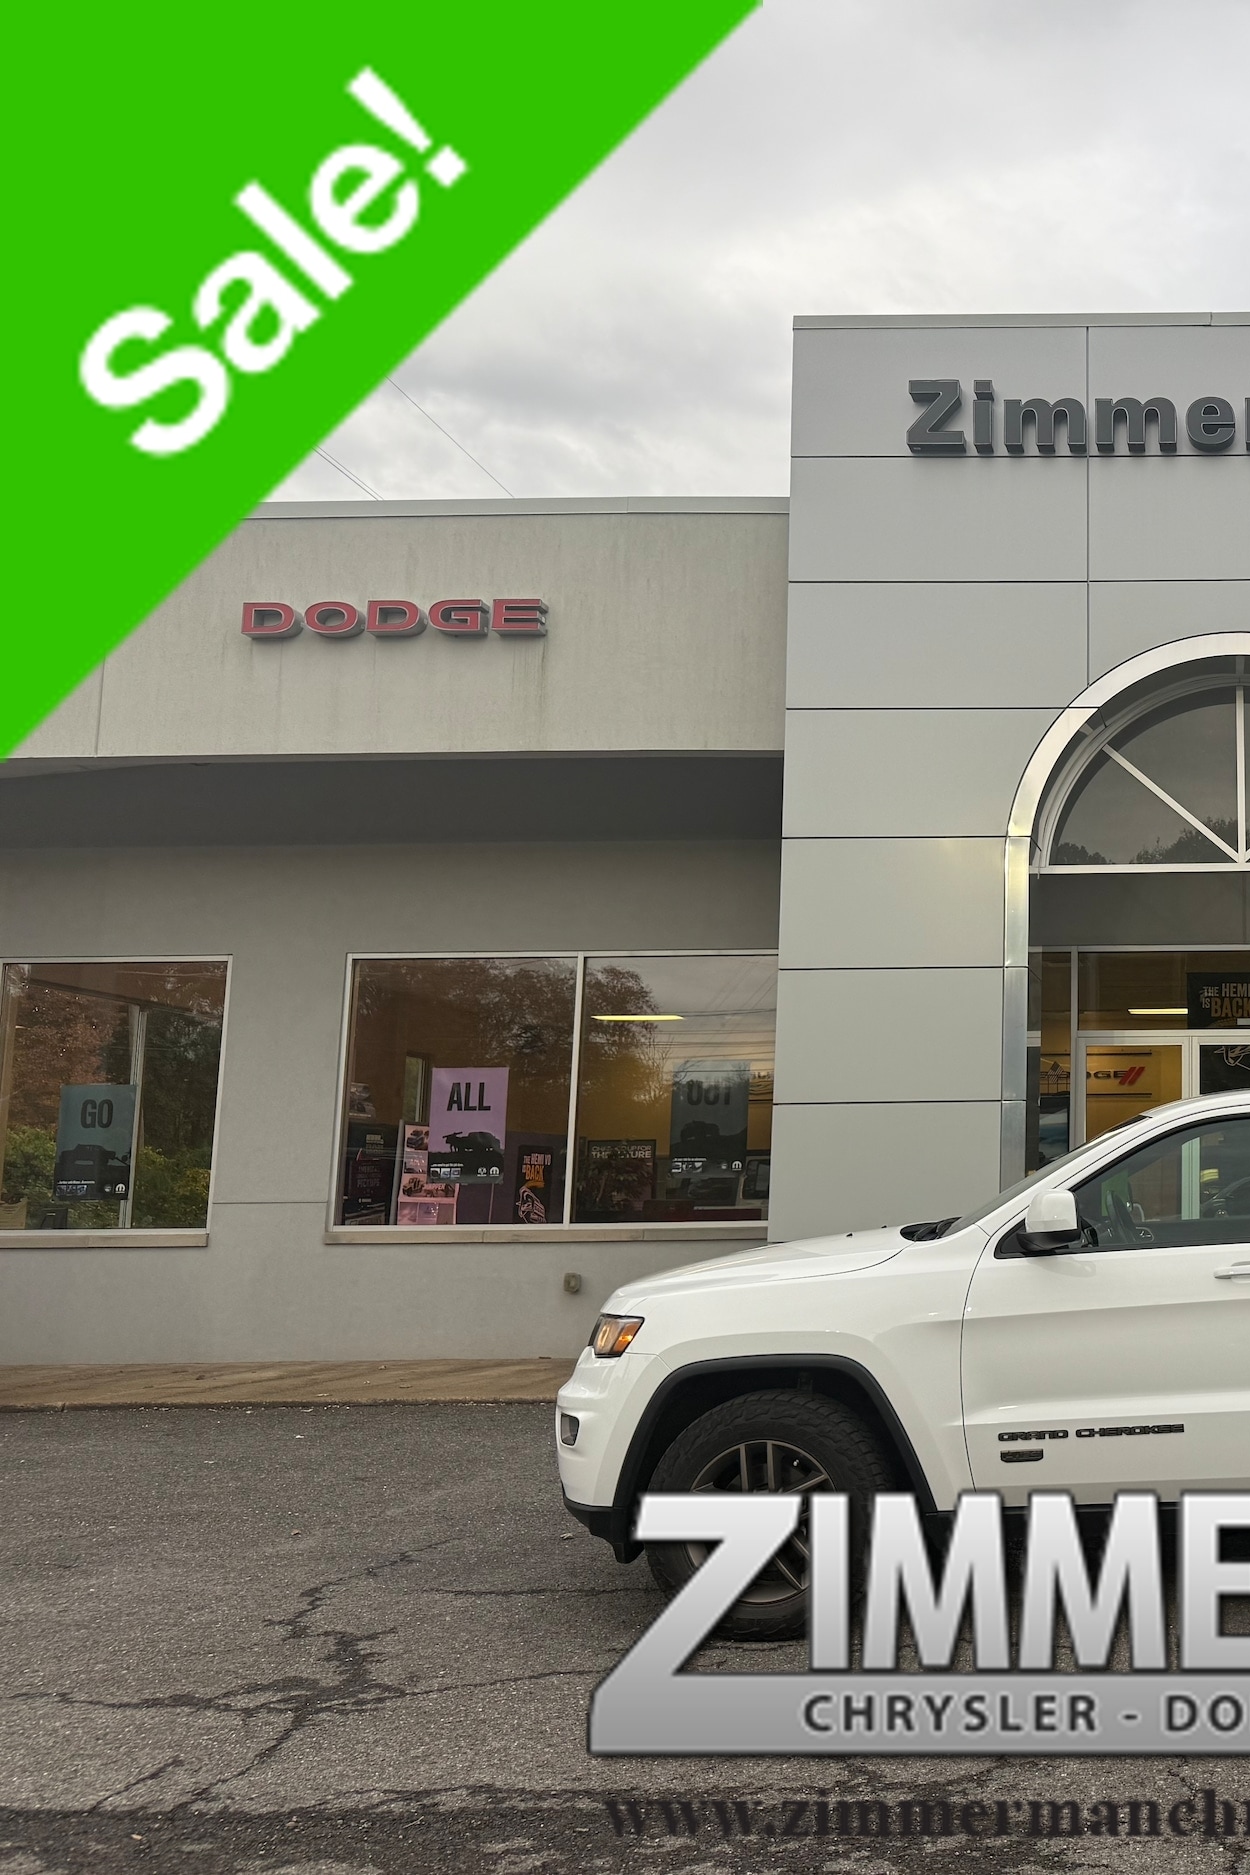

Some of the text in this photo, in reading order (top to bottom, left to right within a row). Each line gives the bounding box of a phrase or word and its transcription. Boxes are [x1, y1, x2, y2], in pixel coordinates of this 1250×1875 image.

[241, 598, 549, 641] DODGE
[1202, 986, 1219, 996] THE
[1202, 998, 1210, 1008] IS
[447, 1082, 491, 1112] ALL
[80, 1099, 114, 1129] GO
[526, 1164, 545, 1181] BACK
[998, 1423, 1185, 1442] GRAND CHEROKEE
